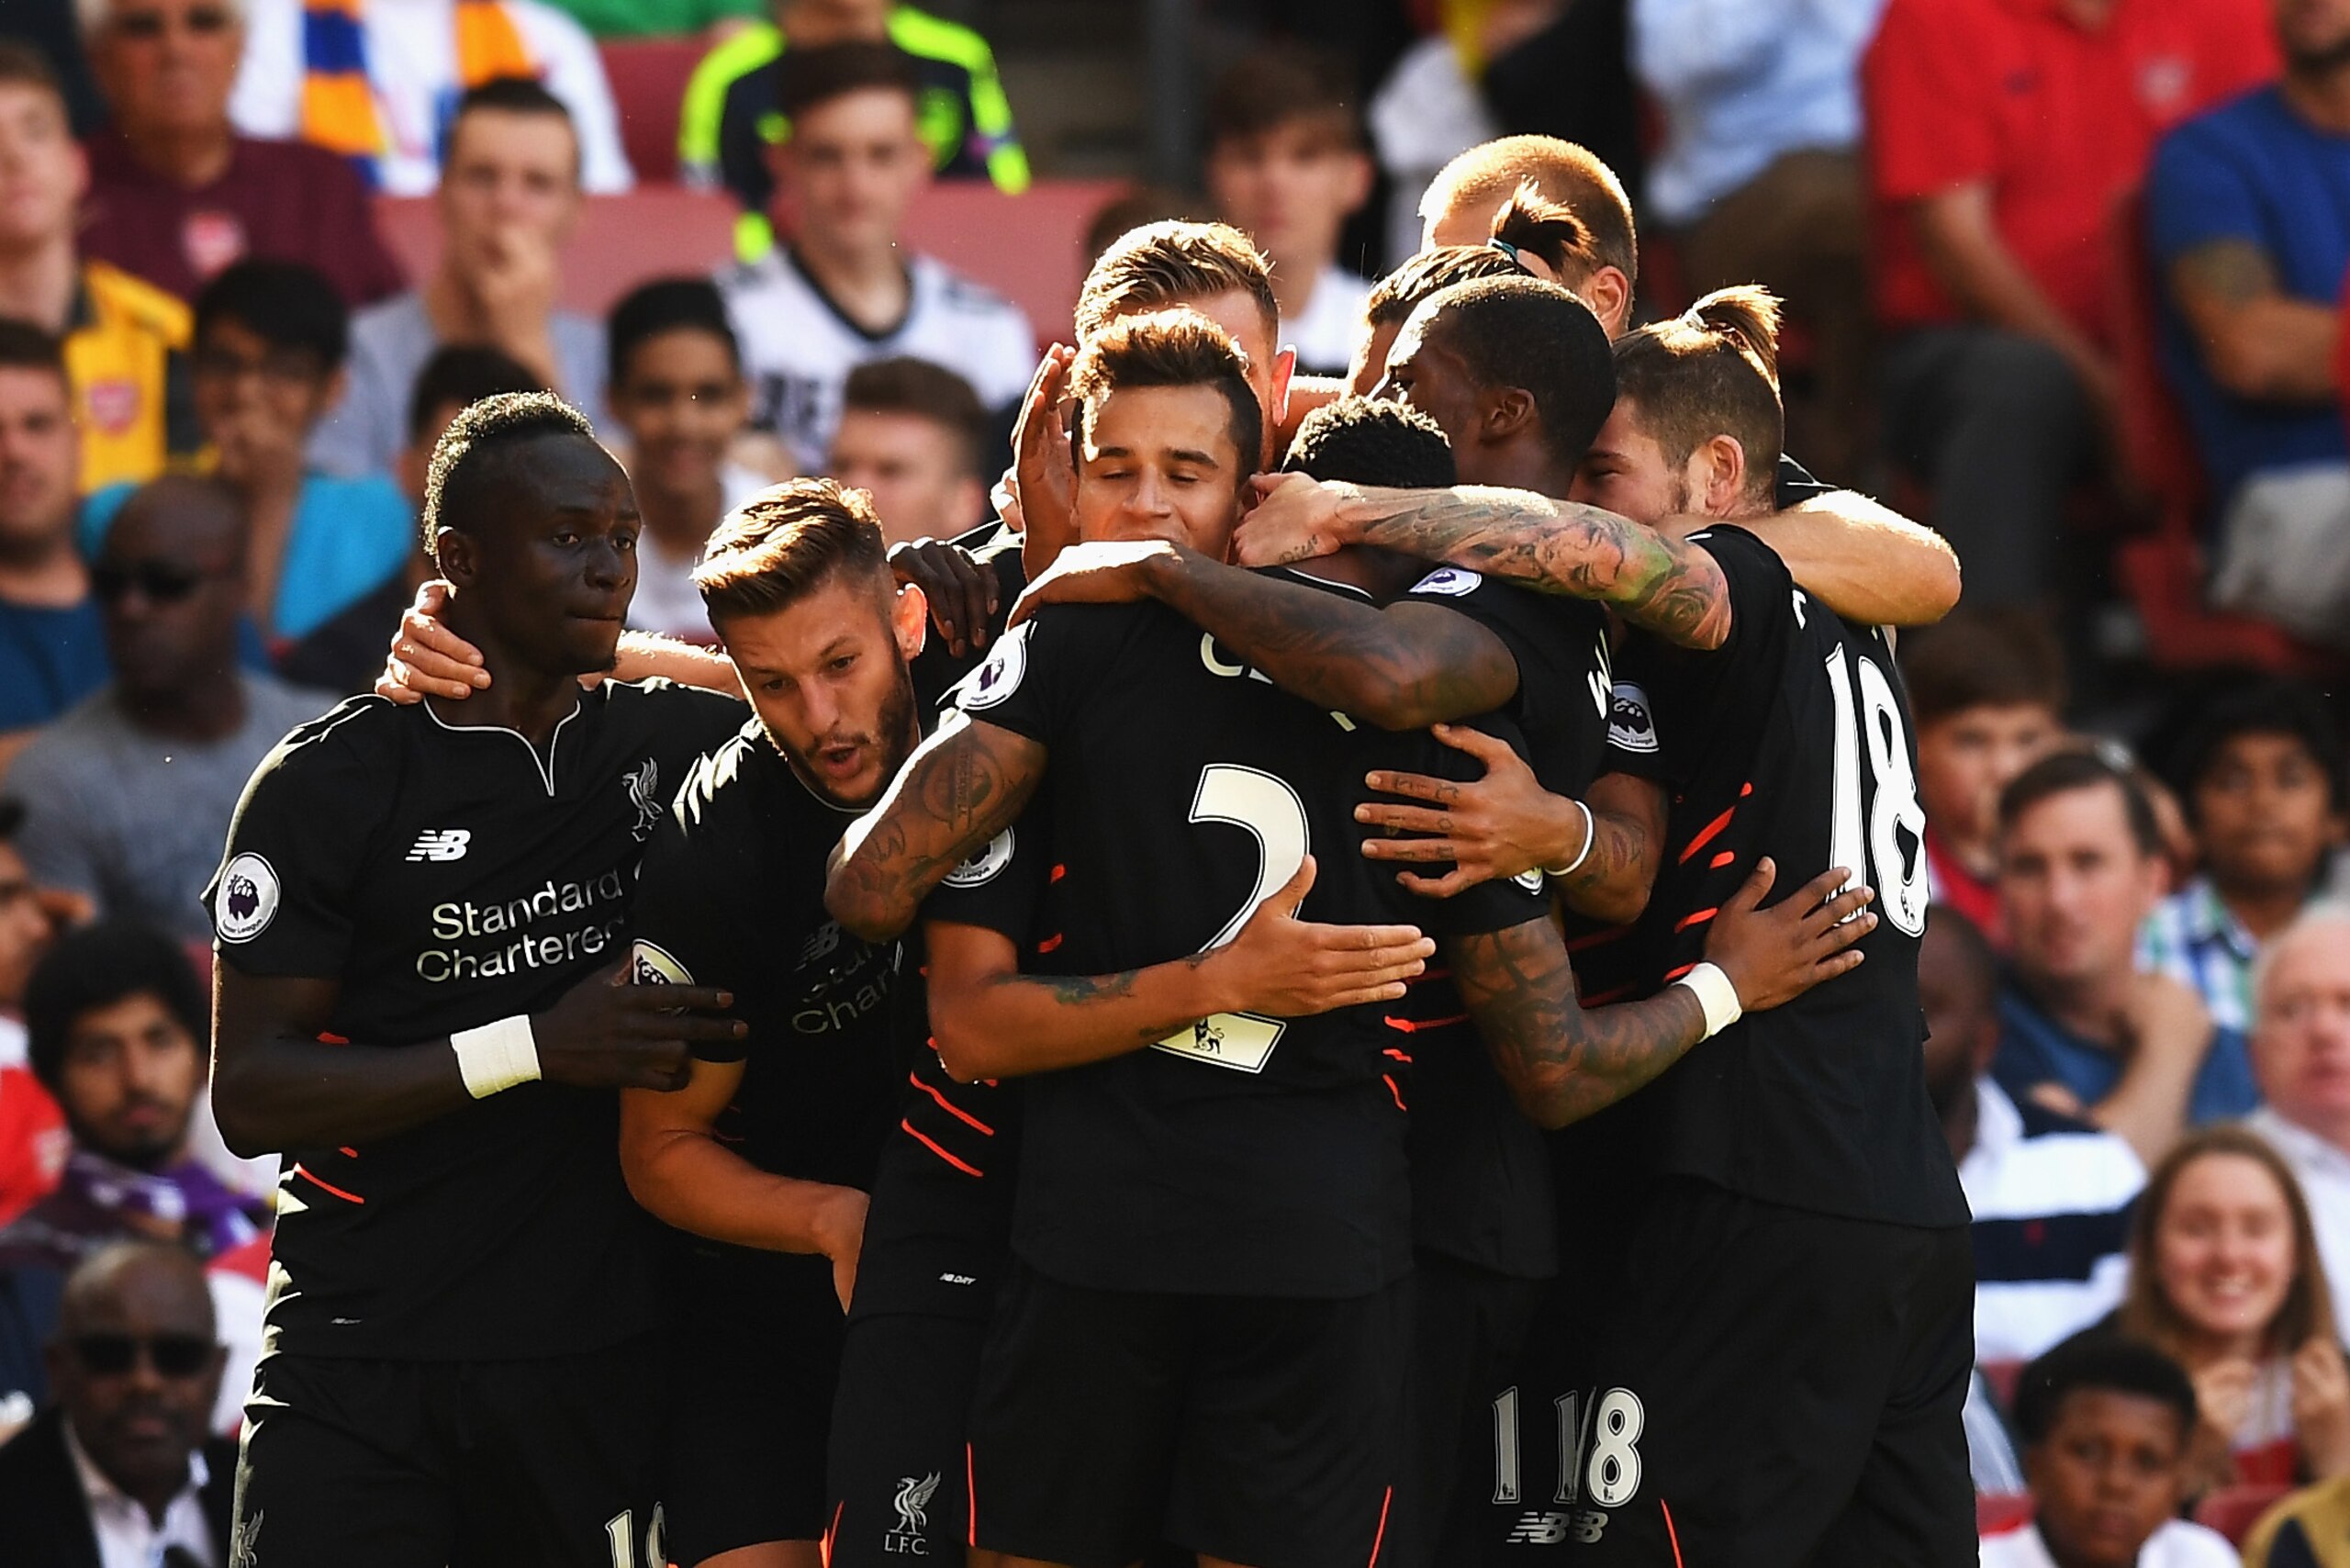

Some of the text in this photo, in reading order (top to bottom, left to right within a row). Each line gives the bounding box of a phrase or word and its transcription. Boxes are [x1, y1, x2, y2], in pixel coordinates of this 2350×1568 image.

[1825, 641, 1931, 938] 18
[431, 868, 623, 940] Standard
[1150, 763, 1311, 1074] 2
[884, 1534, 930, 1555] L.F.C.
